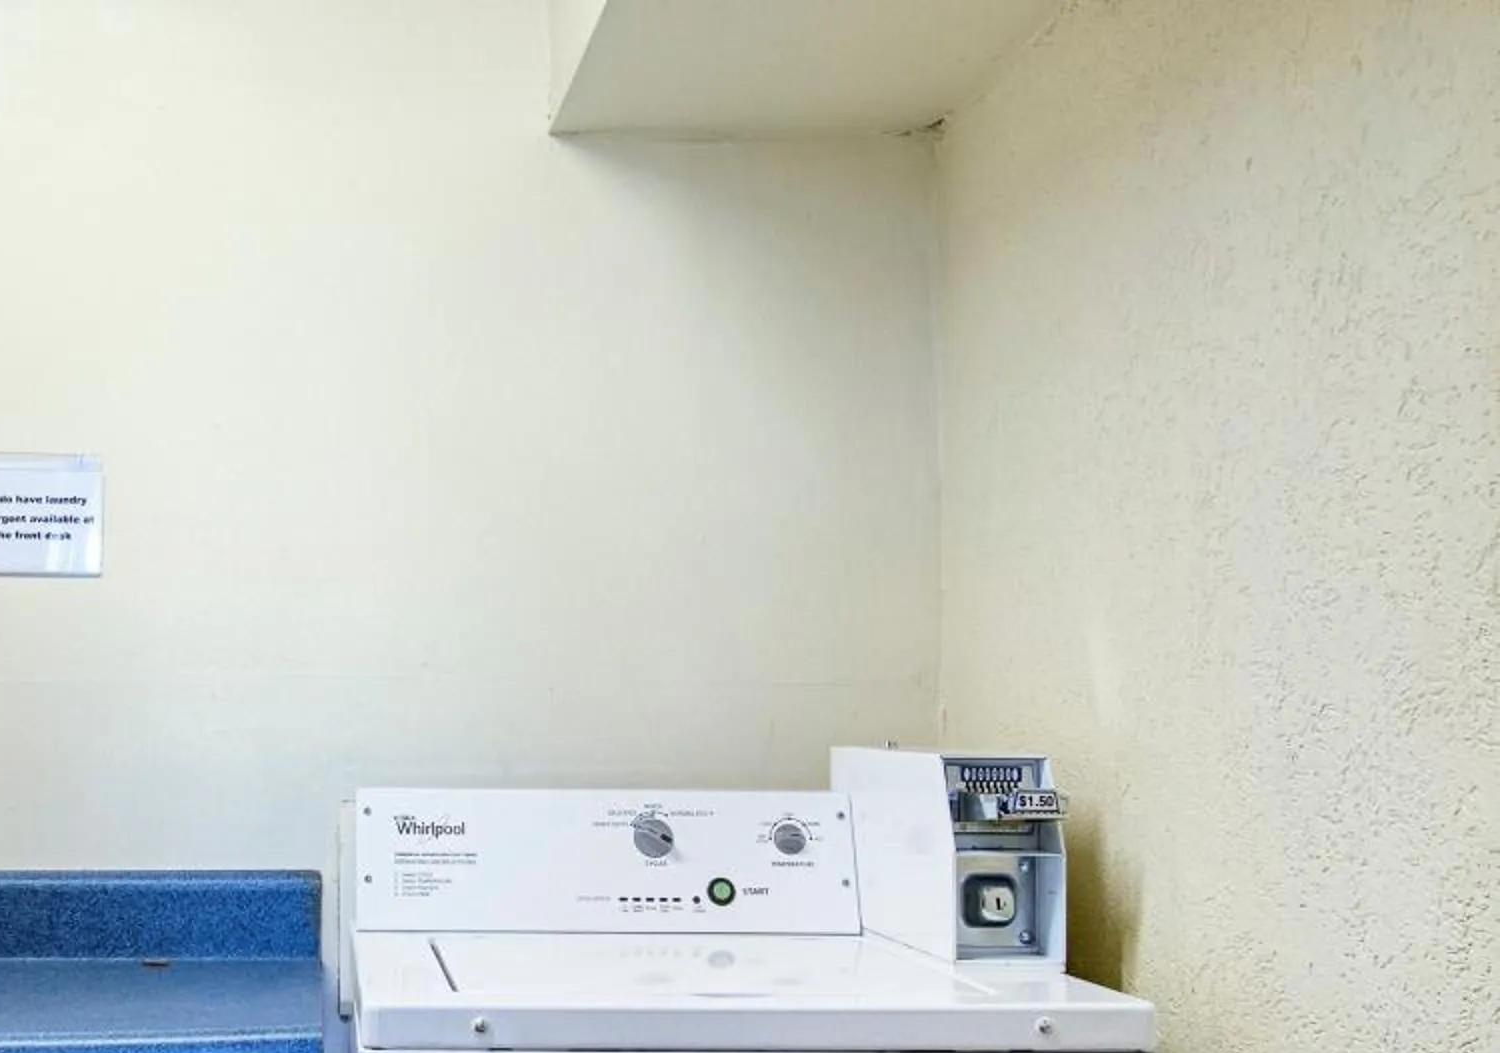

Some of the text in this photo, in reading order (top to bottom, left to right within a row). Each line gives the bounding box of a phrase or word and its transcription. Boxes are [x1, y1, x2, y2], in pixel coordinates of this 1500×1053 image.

[0, 495, 13, 504] do
[16, 495, 43, 504] have
[45, 495, 87, 506] laundry
[29, 514, 80, 524] available
[15, 531, 41, 540] front
[1019, 795, 1054, 807] $1.50
[395, 821, 466, 839] Whirlpool
[742, 886, 770, 897] START
